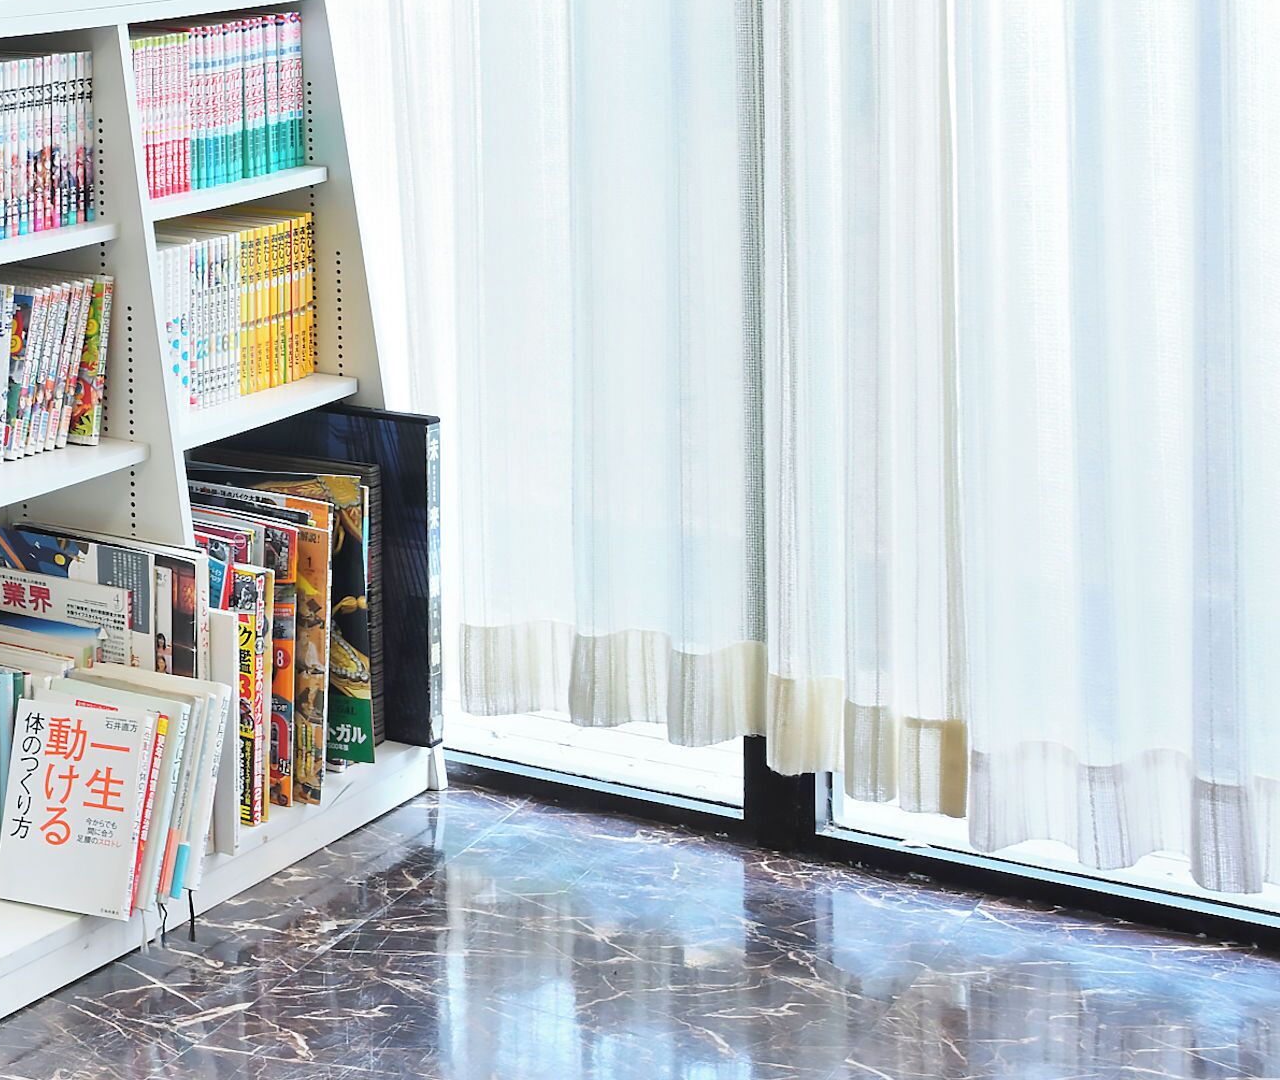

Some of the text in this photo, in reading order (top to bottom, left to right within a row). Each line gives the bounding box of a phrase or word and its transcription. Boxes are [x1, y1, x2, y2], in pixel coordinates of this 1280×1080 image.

[277, 650, 284, 667] 8
[105, 717, 138, 732] 石井直方
[10, 712, 45, 839] 体のつくり方
[40, 716, 87, 846] 動ける
[83, 741, 130, 812] 一生
[85, 818, 118, 829] 今からでも
[87, 827, 114, 838] 間に合う
